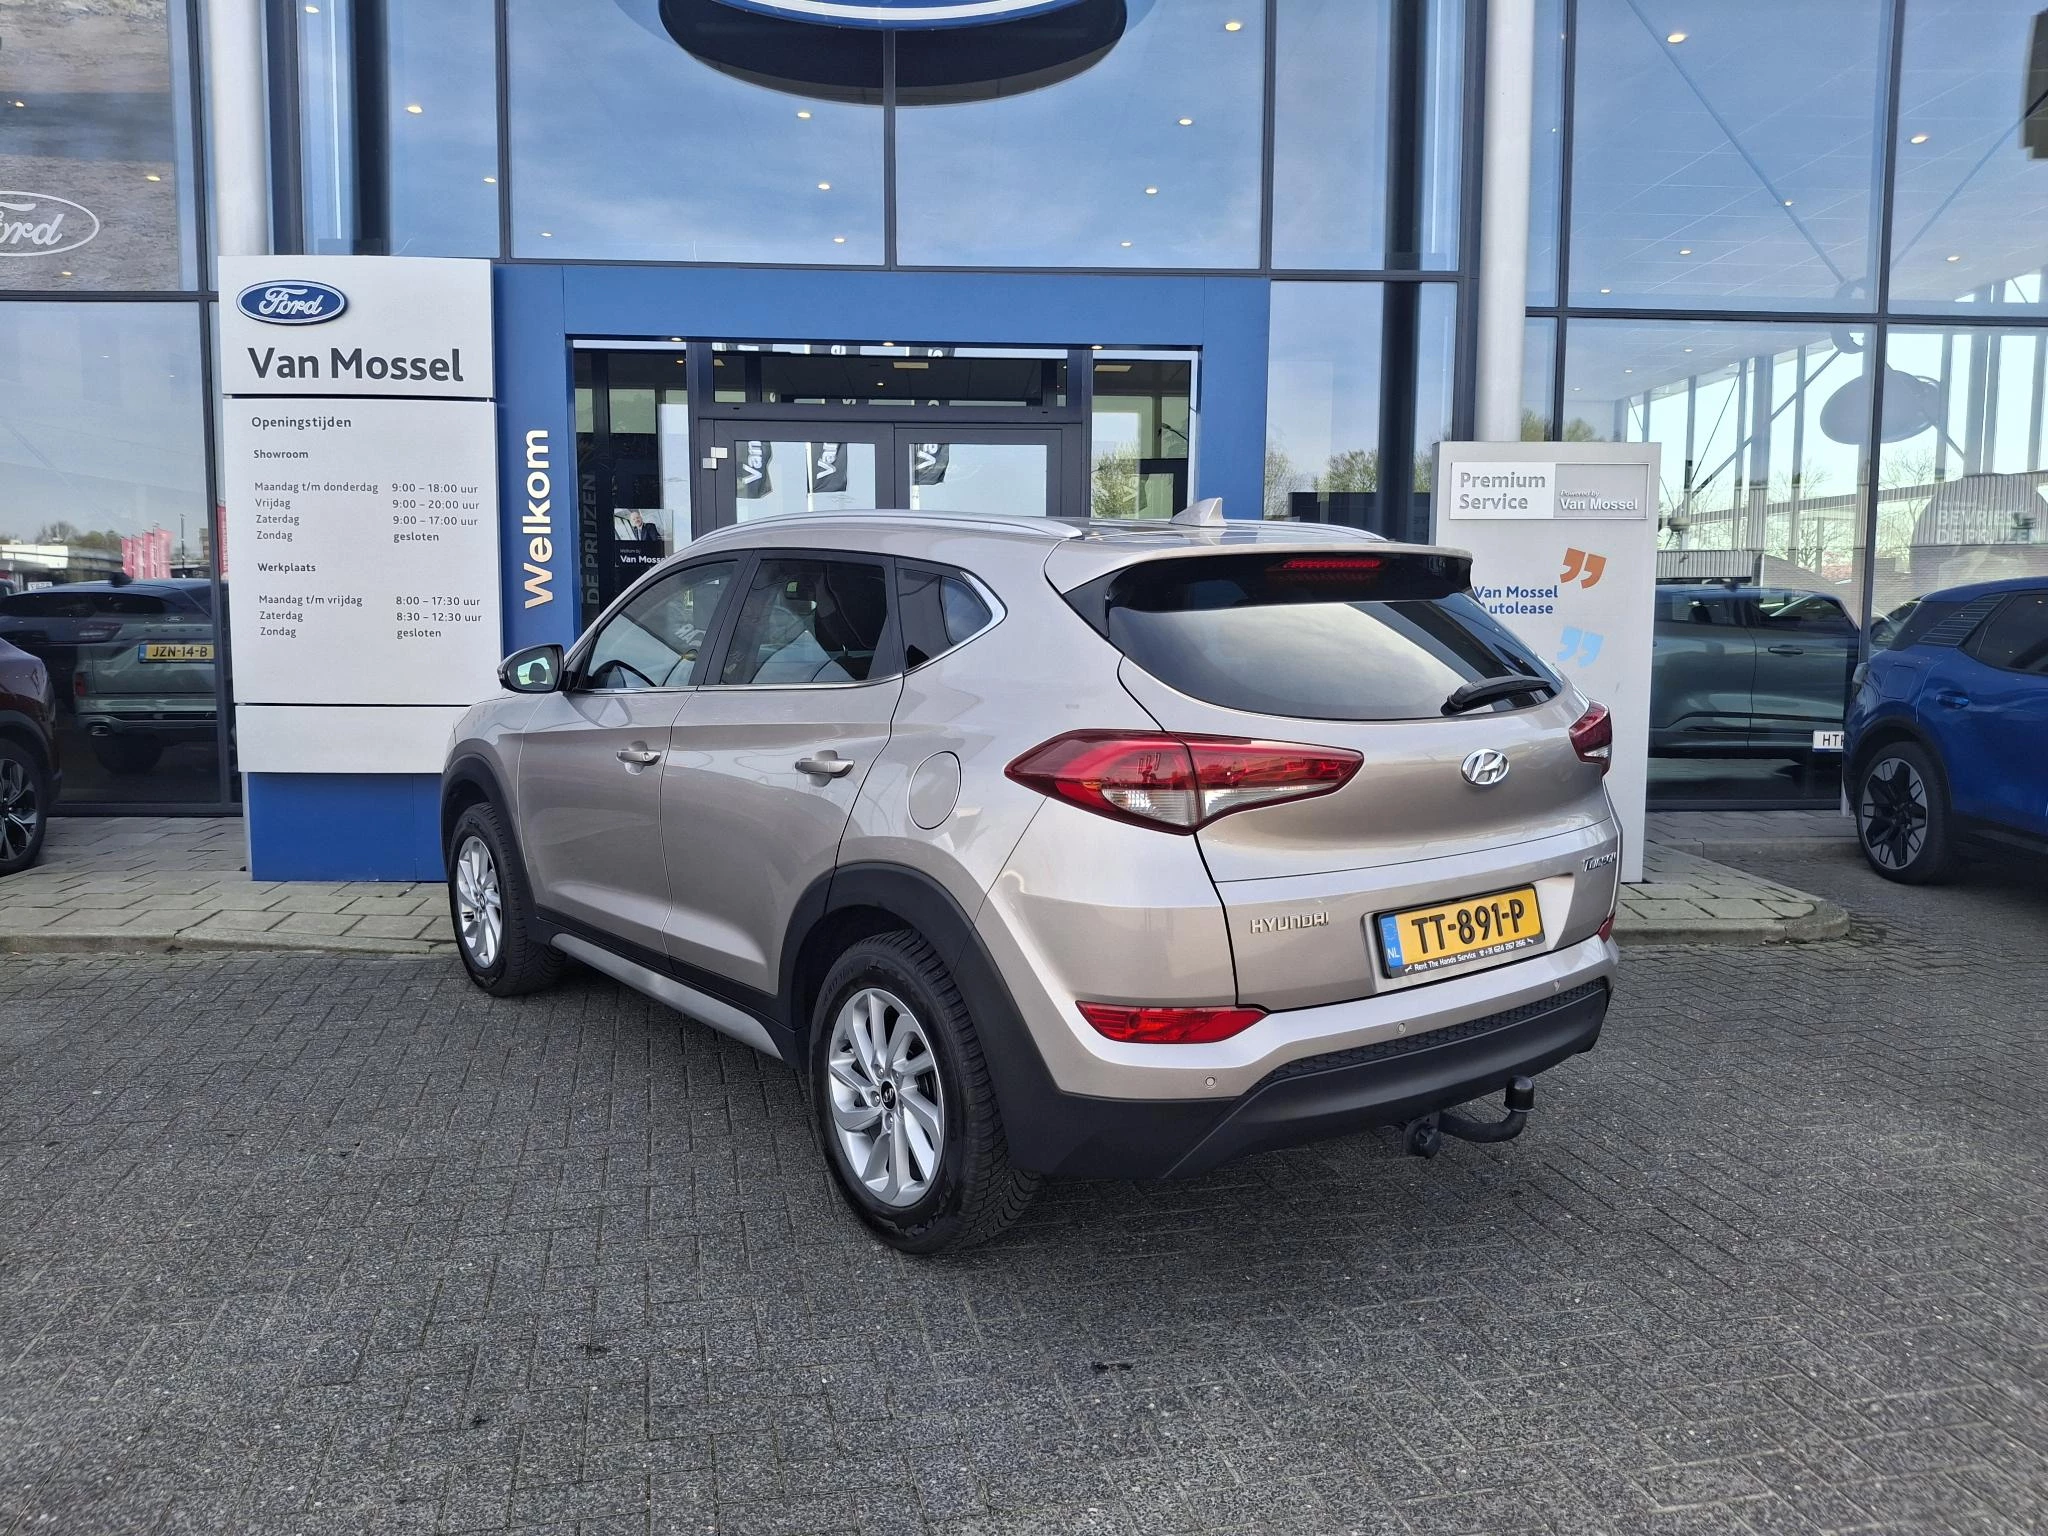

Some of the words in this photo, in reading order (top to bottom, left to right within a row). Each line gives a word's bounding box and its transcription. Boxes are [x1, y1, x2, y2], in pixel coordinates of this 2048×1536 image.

[0, 202, 64, 245] ord
[258, 287, 324, 316] Ford
[247, 347, 320, 379] Van
[330, 347, 465, 382] Mossel
[251, 415, 352, 431] Openingstijden
[253, 449, 309, 459] Showroom
[1458, 471, 1546, 488] Premium
[254, 481, 300, 495] Maandag
[301, 481, 321, 492] t/m
[323, 481, 379, 495] donderdag
[391, 482, 416, 493] 9:00
[427, 483, 458, 494] 18:00
[460, 486, 479, 494] uur
[254, 497, 291, 511] Vrijdag
[392, 499, 417, 509] 9:00
[428, 499, 459, 510] 20:00
[462, 502, 480, 510] uur
[1458, 493, 1529, 510] Service
[1560, 497, 1586, 510] Van
[1589, 497, 1639, 510] Mossel
[255, 513, 300, 527] Zaterdag
[392, 515, 417, 525] 9:00
[428, 515, 458, 526] 17:00
[460, 518, 478, 526] uur
[522, 429, 554, 609] Welkom
[256, 530, 293, 543] Zondag
[393, 531, 440, 544] gesloten
[620, 555, 637, 563] Van
[257, 562, 316, 575] Werkplaats
[1474, 585, 1502, 599] Van
[1506, 584, 1559, 599] Mossel
[258, 594, 304, 607] Maandag
[305, 594, 325, 605] t/m
[326, 594, 363, 608] vrijdag
[395, 596, 420, 606] 8:00
[431, 596, 460, 607] 17:30
[462, 599, 481, 607] uur
[259, 610, 304, 623] Zaterdag
[396, 611, 420, 622] 8:30
[431, 612, 462, 623] 12:30
[464, 615, 482, 623] uur
[259, 626, 297, 639] Zondag
[396, 627, 442, 640] gesloten
[1250, 911, 1329, 934] HYUNDAI
[1411, 898, 1525, 954] TT-891-P
[1387, 947, 1400, 960] NL
[1457, 952, 1476, 962] Service
